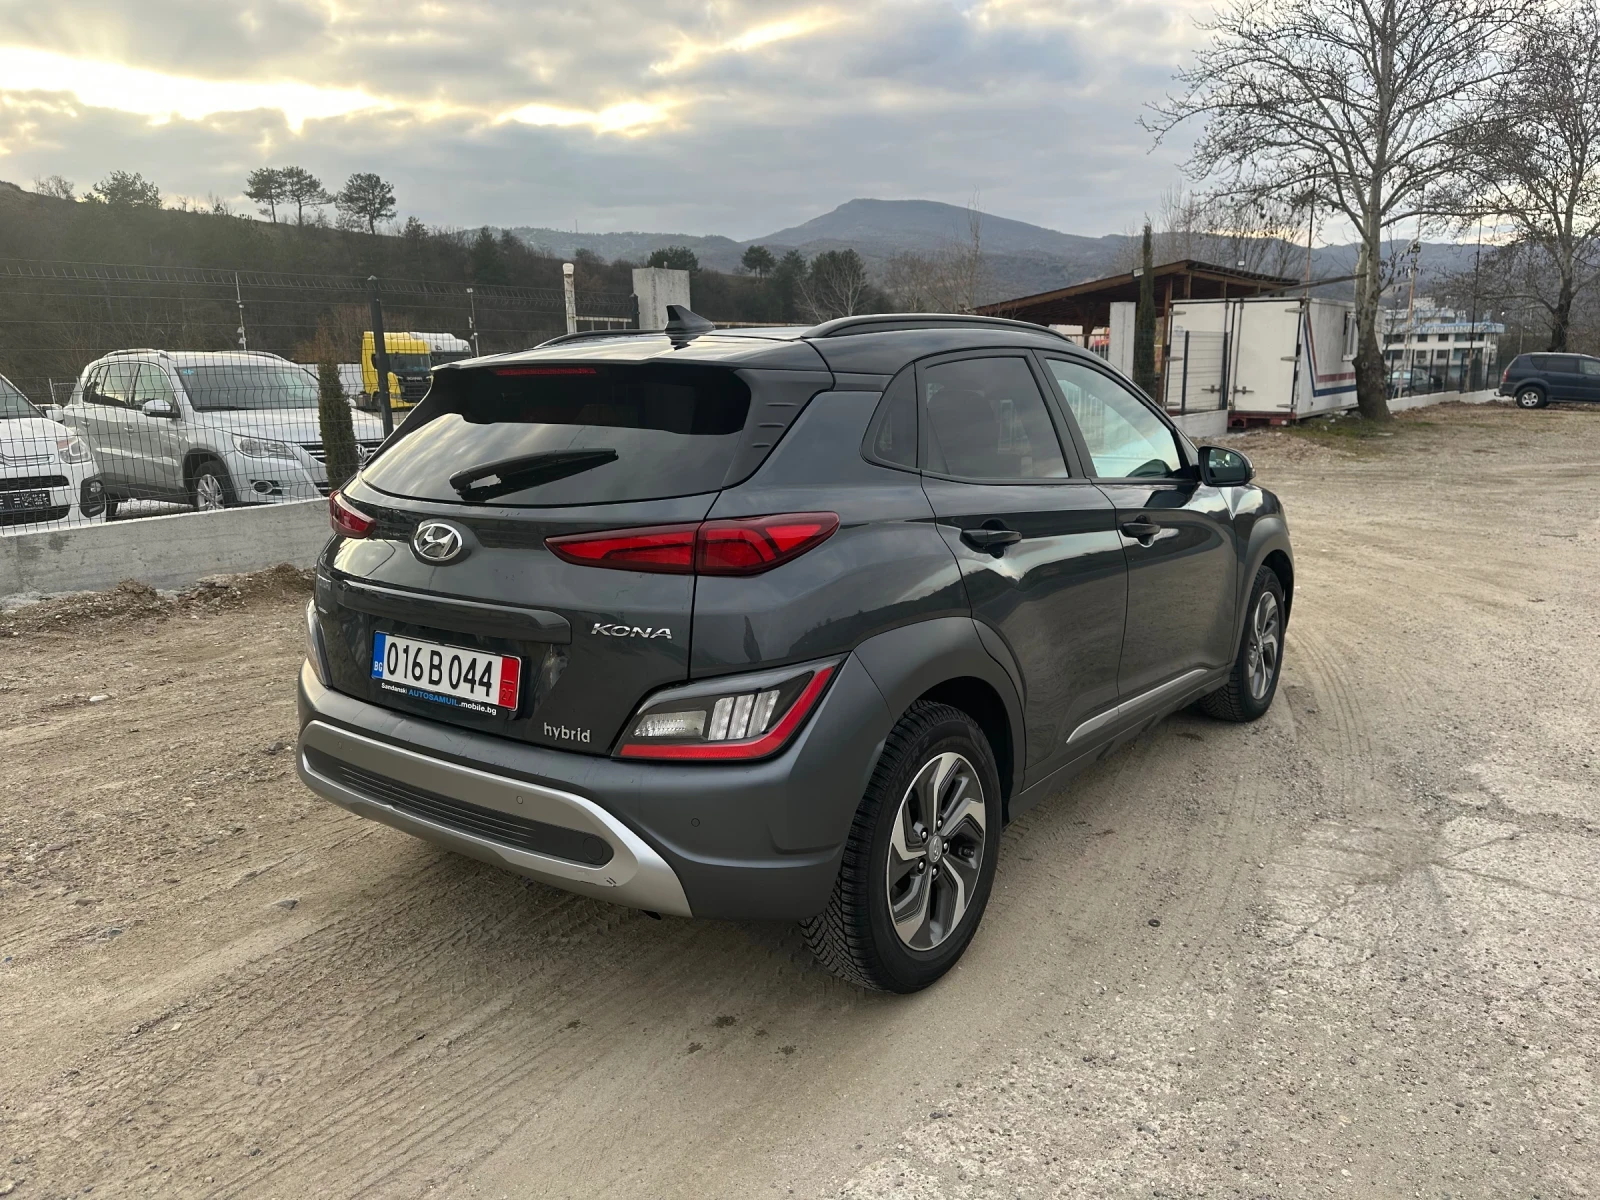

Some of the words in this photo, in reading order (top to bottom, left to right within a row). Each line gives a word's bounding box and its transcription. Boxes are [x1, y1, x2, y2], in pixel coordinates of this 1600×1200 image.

[591, 623, 672, 639] KONA
[373, 661, 383, 672] BG
[381, 683, 408, 694] Sandanski
[501, 688, 514, 701] 27
[544, 722, 591, 743] hybrid
